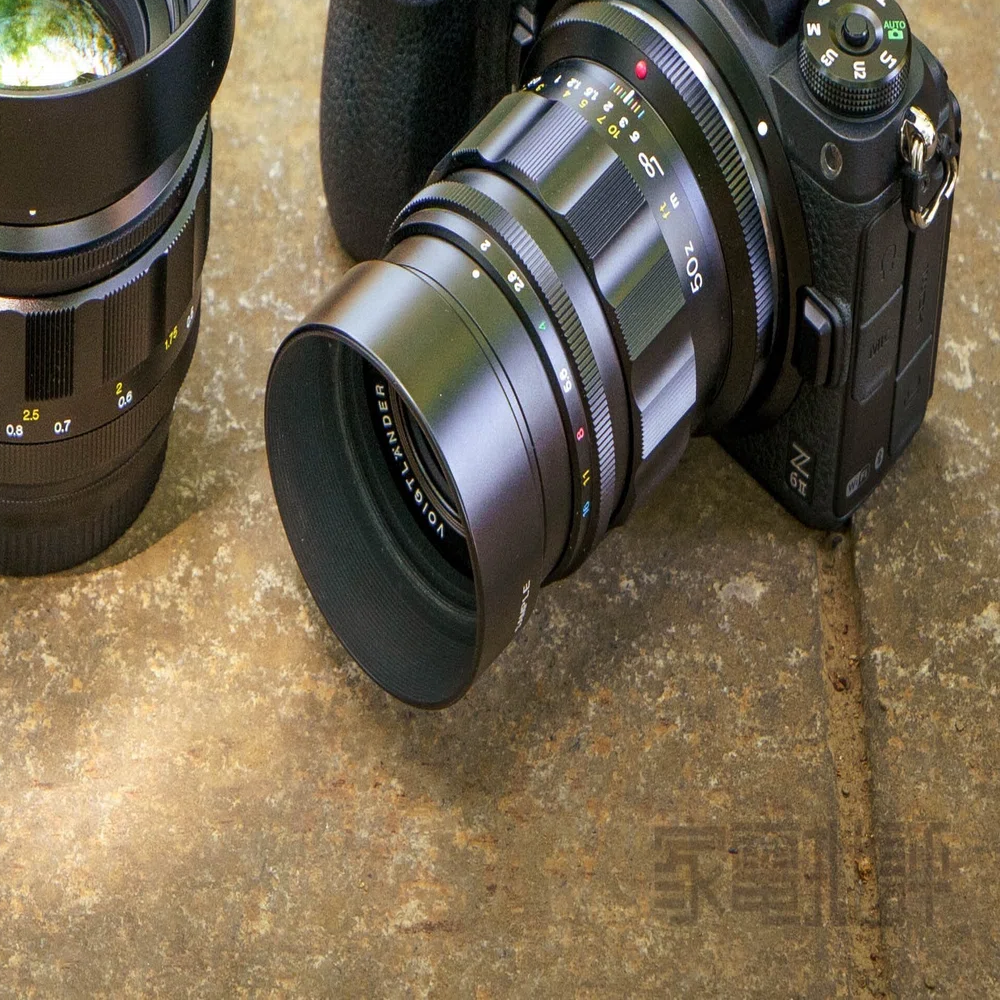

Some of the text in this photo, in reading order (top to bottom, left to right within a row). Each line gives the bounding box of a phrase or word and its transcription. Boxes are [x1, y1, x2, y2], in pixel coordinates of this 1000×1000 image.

[807, 22, 821, 37] M
[883, 20, 906, 31] AUTO
[820, 48, 838, 67] U3
[879, 50, 897, 70] U1
[853, 60, 867, 80] U2
[562, 88, 572, 98] 4
[579, 99, 588, 109] 5
[603, 100, 614, 112] 2
[596, 115, 607, 125] 7
[618, 116, 629, 128] 3
[607, 124, 621, 139] 10
[480, 240, 491, 252] 2
[507, 269, 525, 293] 2.8
[686, 257, 703, 294] 50
[559, 367, 572, 394] 5.6
[22, 408, 40, 421] 2.5
[115, 382, 123, 395] 2
[6, 423, 23, 437] 0.8
[53, 419, 71, 433] 0.7
[118, 390, 133, 408] 0.6
[576, 426, 585, 441] 8
[375, 383, 445, 538] VOIGTLÄNDER
[582, 469, 591, 487] 11
